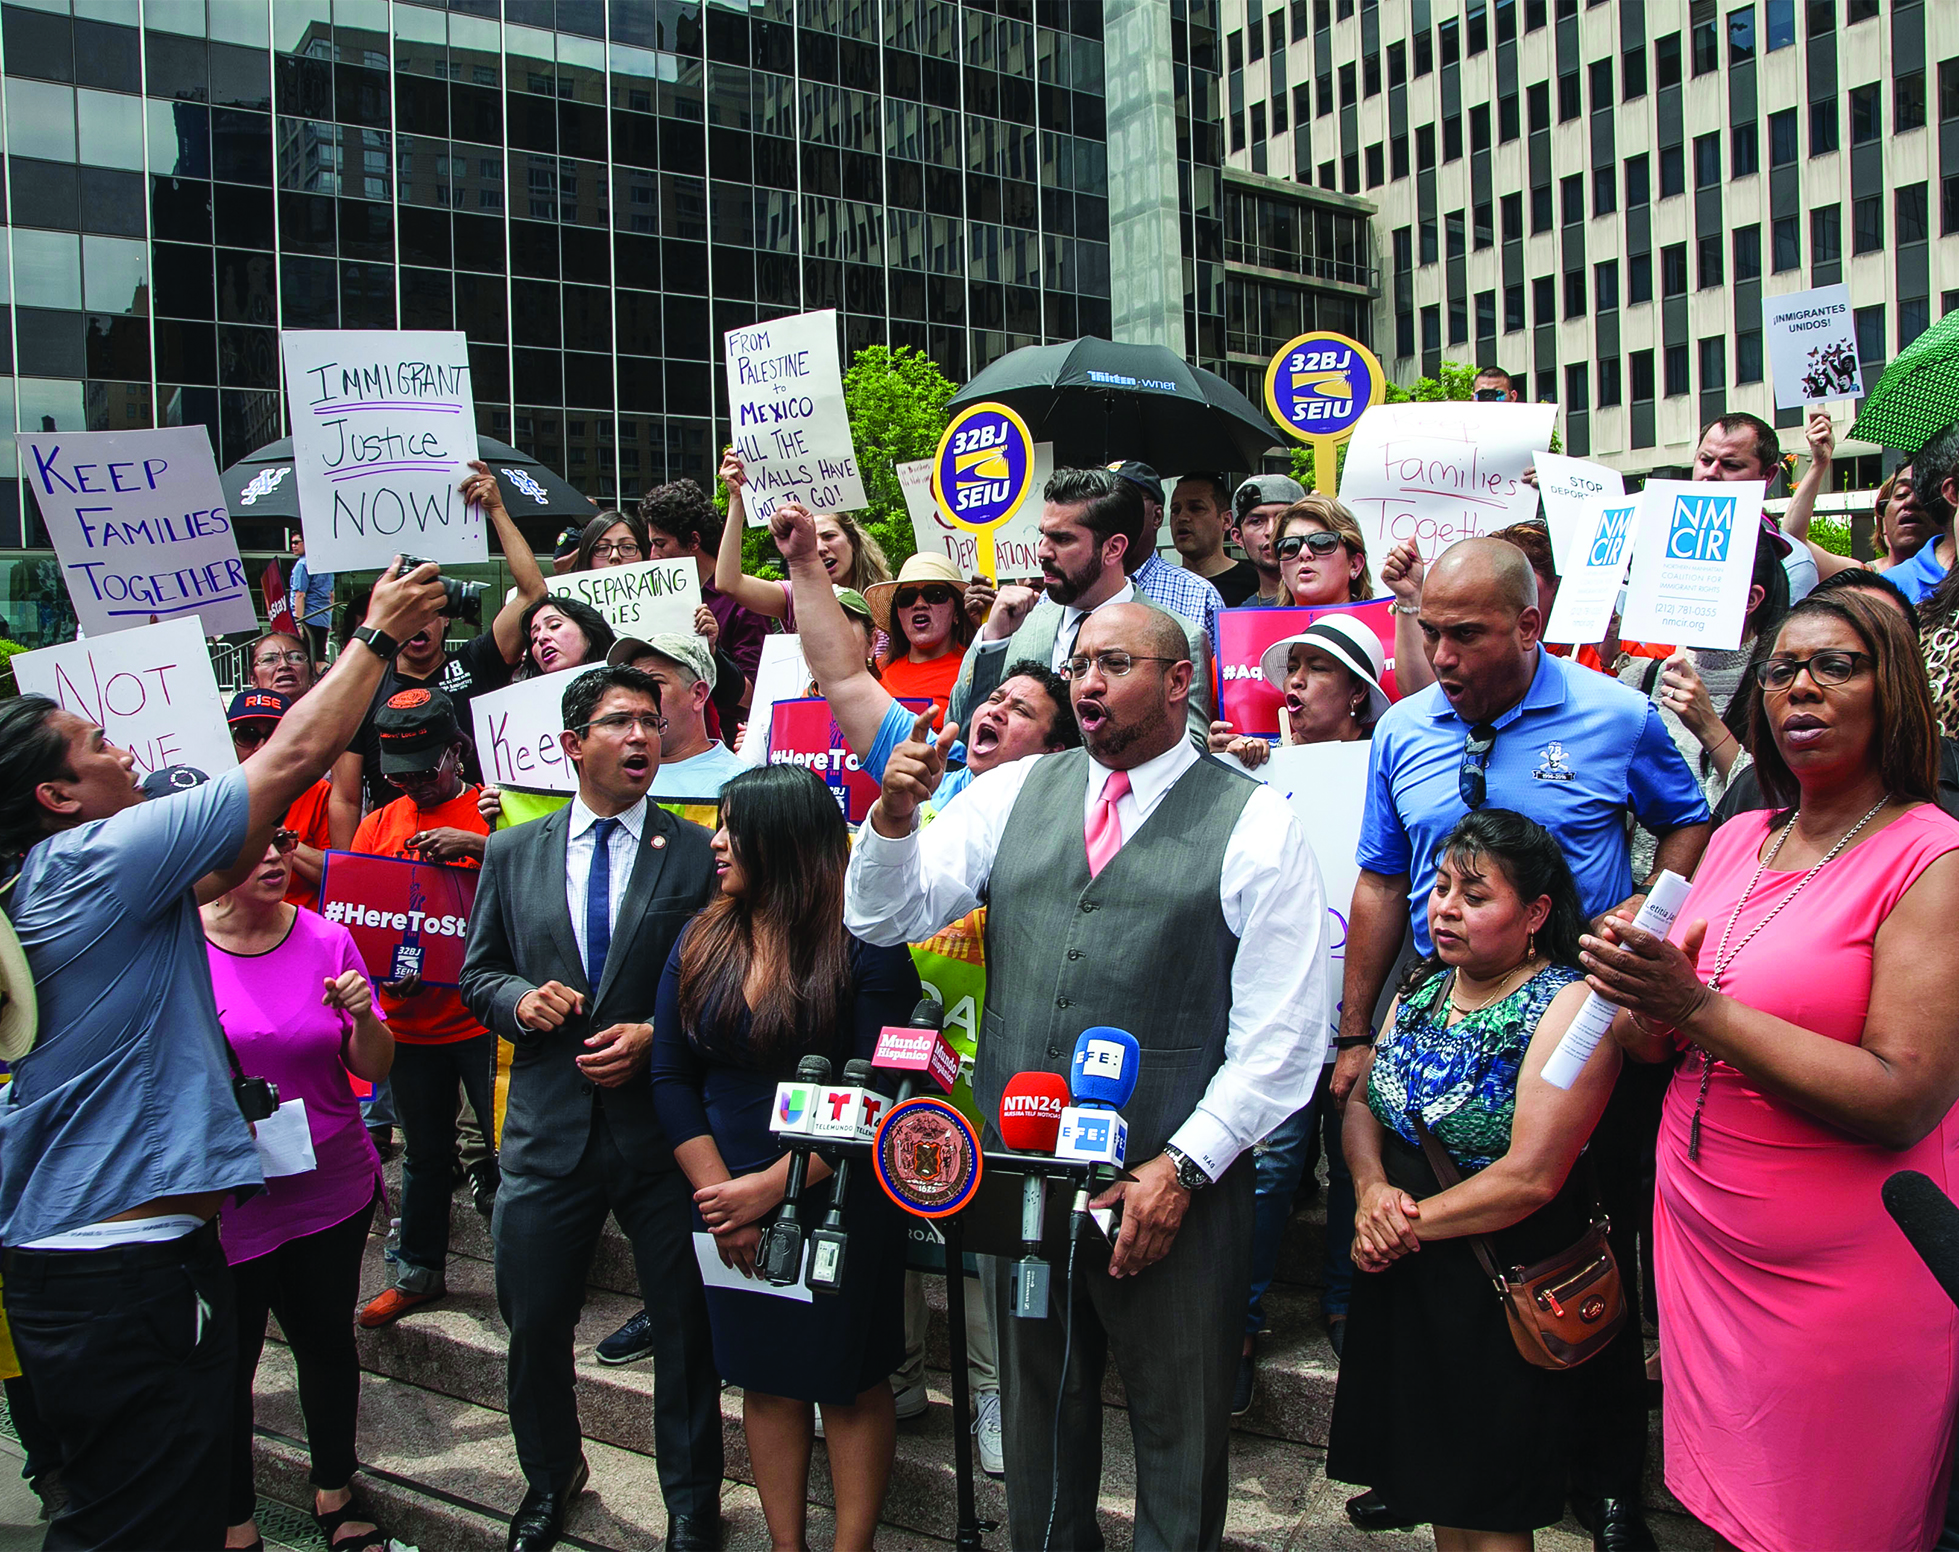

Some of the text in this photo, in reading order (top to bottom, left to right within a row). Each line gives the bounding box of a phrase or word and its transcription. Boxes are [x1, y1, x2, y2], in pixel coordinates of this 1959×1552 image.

[1789, 319, 1831, 333] UNIDOS!
[729, 331, 771, 356] FROM
[738, 351, 810, 385] PALESTINE
[1289, 350, 1352, 373] 32BJ
[306, 362, 470, 405] IMMIGRANT
[773, 383, 787, 395] to
[740, 396, 814, 426] MEXICO
[1292, 400, 1353, 420] SEIU
[322, 419, 447, 467] Justice
[735, 429, 809, 463] ALL THE
[953, 421, 1009, 455] 32BJ
[31, 444, 168, 495] KEEP
[746, 458, 855, 494] WALLS HAVE
[1379, 441, 1517, 496] Families
[956, 480, 1010, 511] SEIU
[1569, 476, 1603, 493] STOP
[751, 496, 775, 521] GOT
[810, 485, 844, 509] GO!
[1673, 497, 1732, 530] NM
[75, 507, 230, 548] FAMILIES
[1671, 527, 1723, 560] CIR
[68, 558, 247, 606] TOGETHER
[1660, 582, 1720, 593] IMMIGRANT RIGHTS
[1661, 572, 1722, 583] COALITION FOR
[1655, 603, 1717, 617] (212) 781-0355
[1662, 618, 1705, 632] nmcir.org
[56, 650, 177, 728] NOT
[398, 946, 421, 957] 32BJ
[877, 1047, 928, 1061] Hispánico
[880, 1034, 931, 1050] Mundo
[934, 1041, 957, 1074] Mundo
[1004, 1096, 1061, 1112] NTN24
[815, 1123, 853, 1132] TELEMUNDO
